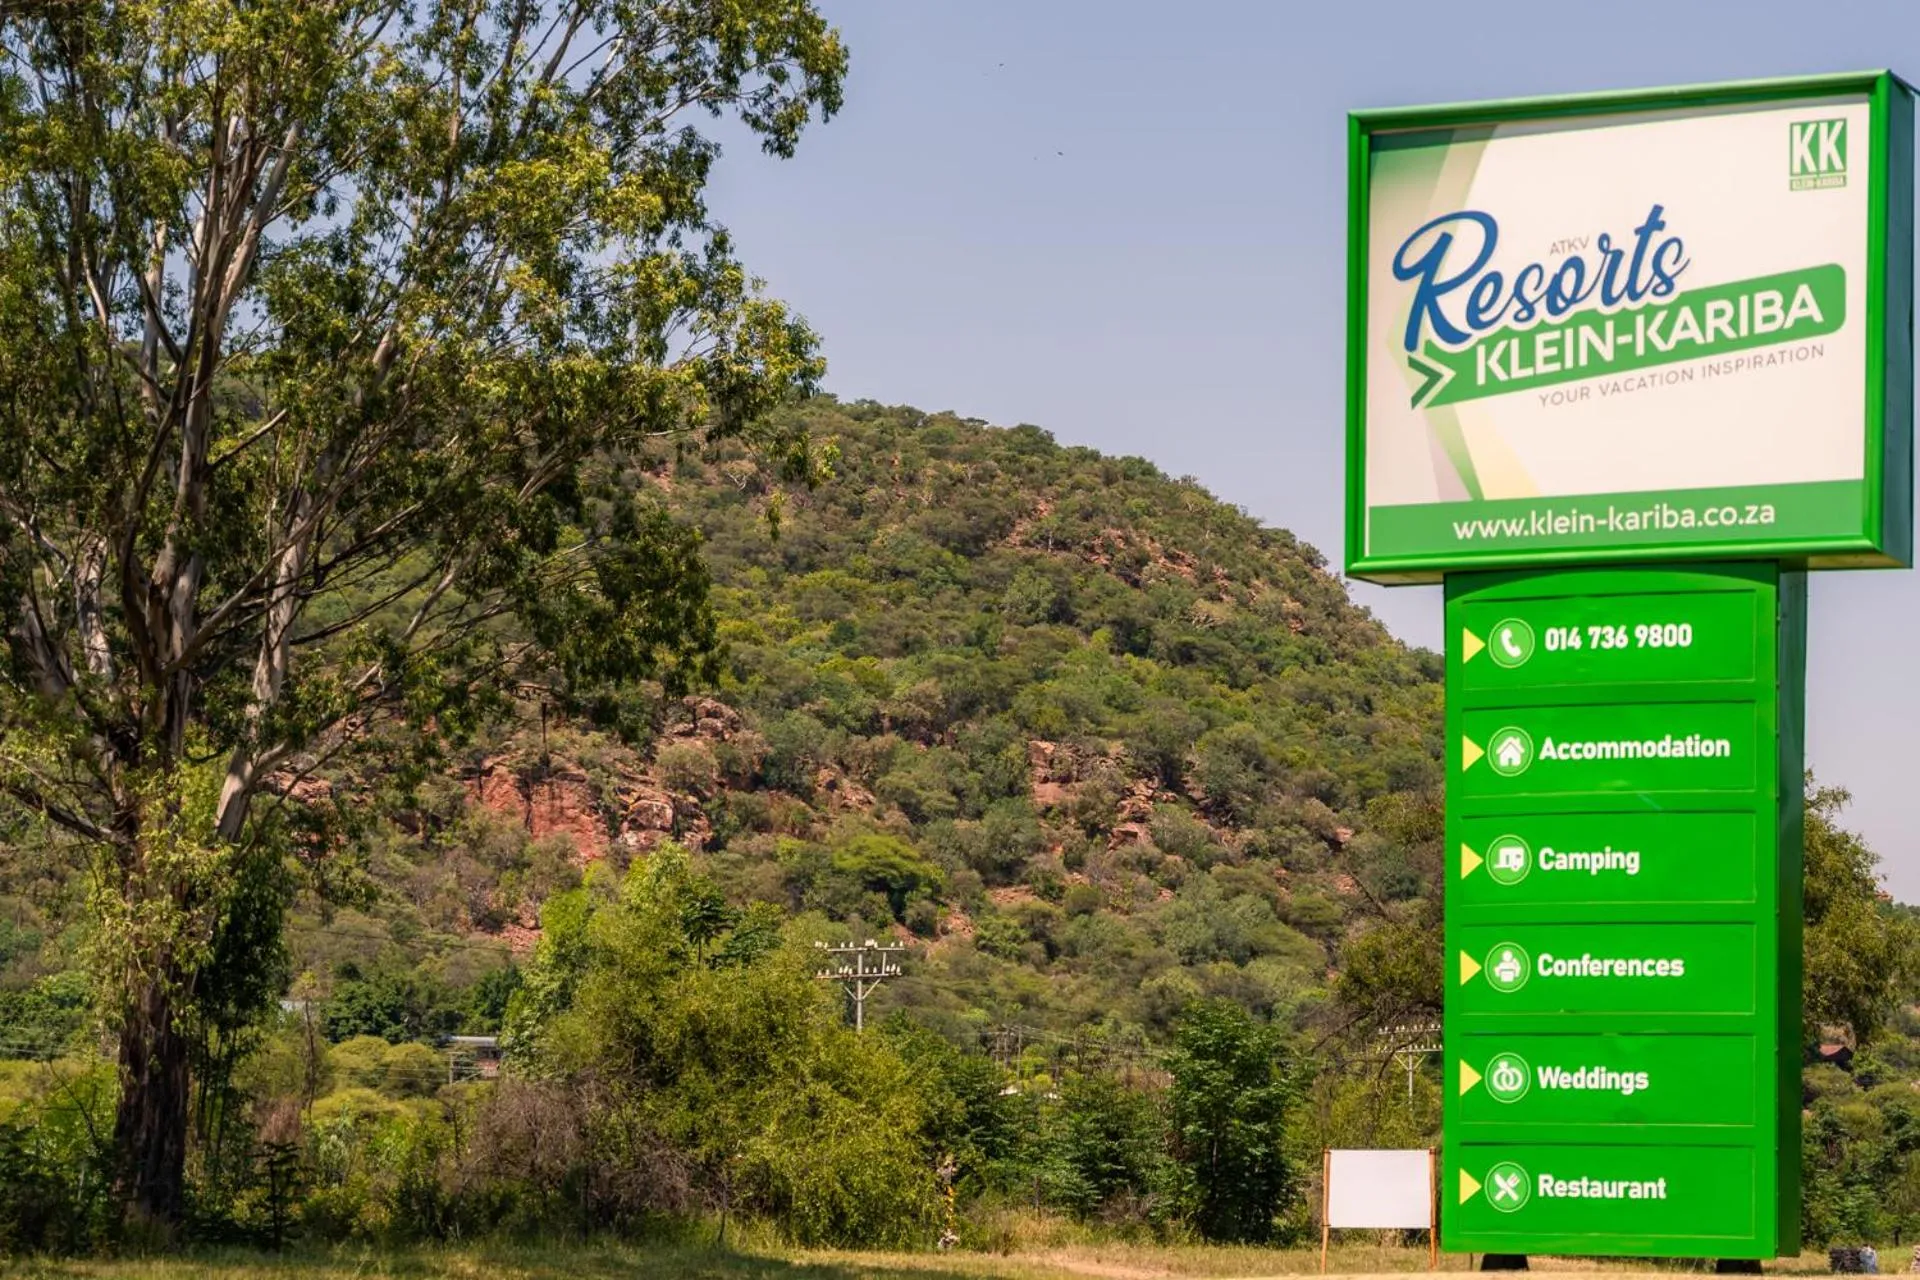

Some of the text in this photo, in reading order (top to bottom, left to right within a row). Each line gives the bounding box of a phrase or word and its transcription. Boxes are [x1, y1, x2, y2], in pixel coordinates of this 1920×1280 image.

[1792, 121, 1844, 174] KK
[1549, 235, 1590, 256] ATKV
[1392, 204, 1690, 352] Resorts
[1476, 283, 1823, 385] KLEIN-KARIBA
[1539, 344, 1825, 409] YOUR VACATION INSPIRATION
[1452, 503, 1775, 540] www.klein-kariba.co.za
[1545, 623, 1692, 651] 014 736 9800
[1539, 734, 1731, 760] Accommodation
[1538, 846, 1640, 875] Camping
[1537, 953, 1684, 977] Conferences
[1537, 1066, 1649, 1095] Weddings
[1538, 1174, 1667, 1199] Restaurant
